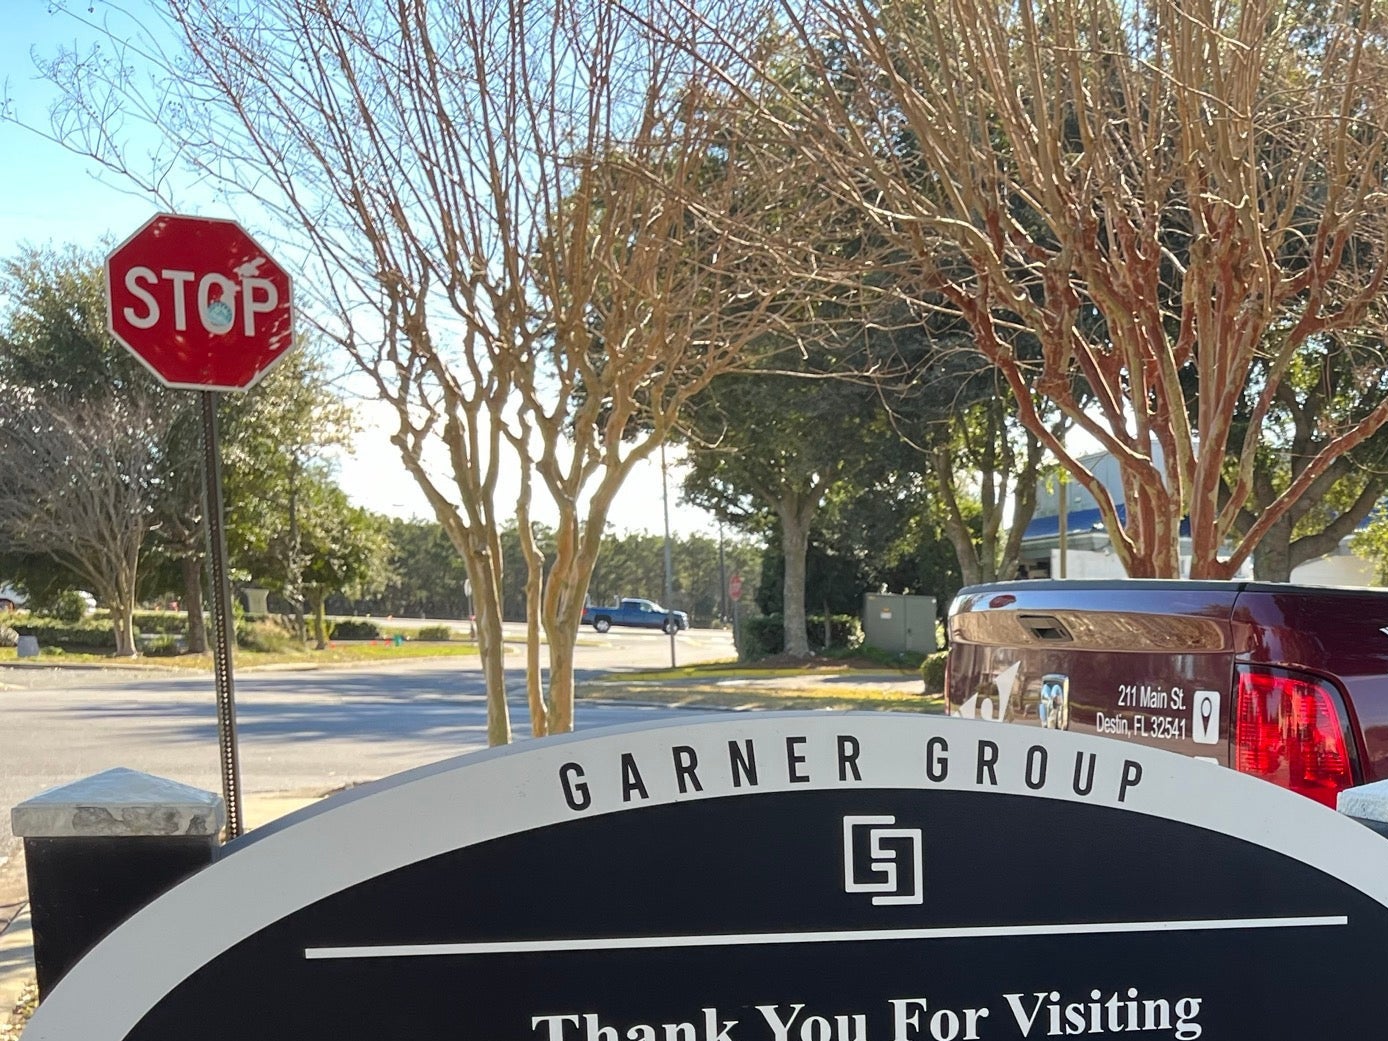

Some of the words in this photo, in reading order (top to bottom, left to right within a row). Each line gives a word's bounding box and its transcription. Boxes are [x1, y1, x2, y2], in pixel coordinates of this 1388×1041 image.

[124, 266, 278, 337] STOP
[1118, 684, 1137, 706] 211
[1140, 686, 1169, 709] Main
[1170, 687, 1186, 710] St.
[1096, 712, 1132, 739] Destin,
[1133, 714, 1149, 737] FL
[1150, 716, 1187, 740] 32541
[558, 734, 863, 812] GARNER
[925, 736, 1143, 802] GROUP
[1003, 987, 1203, 1041] Visiting
